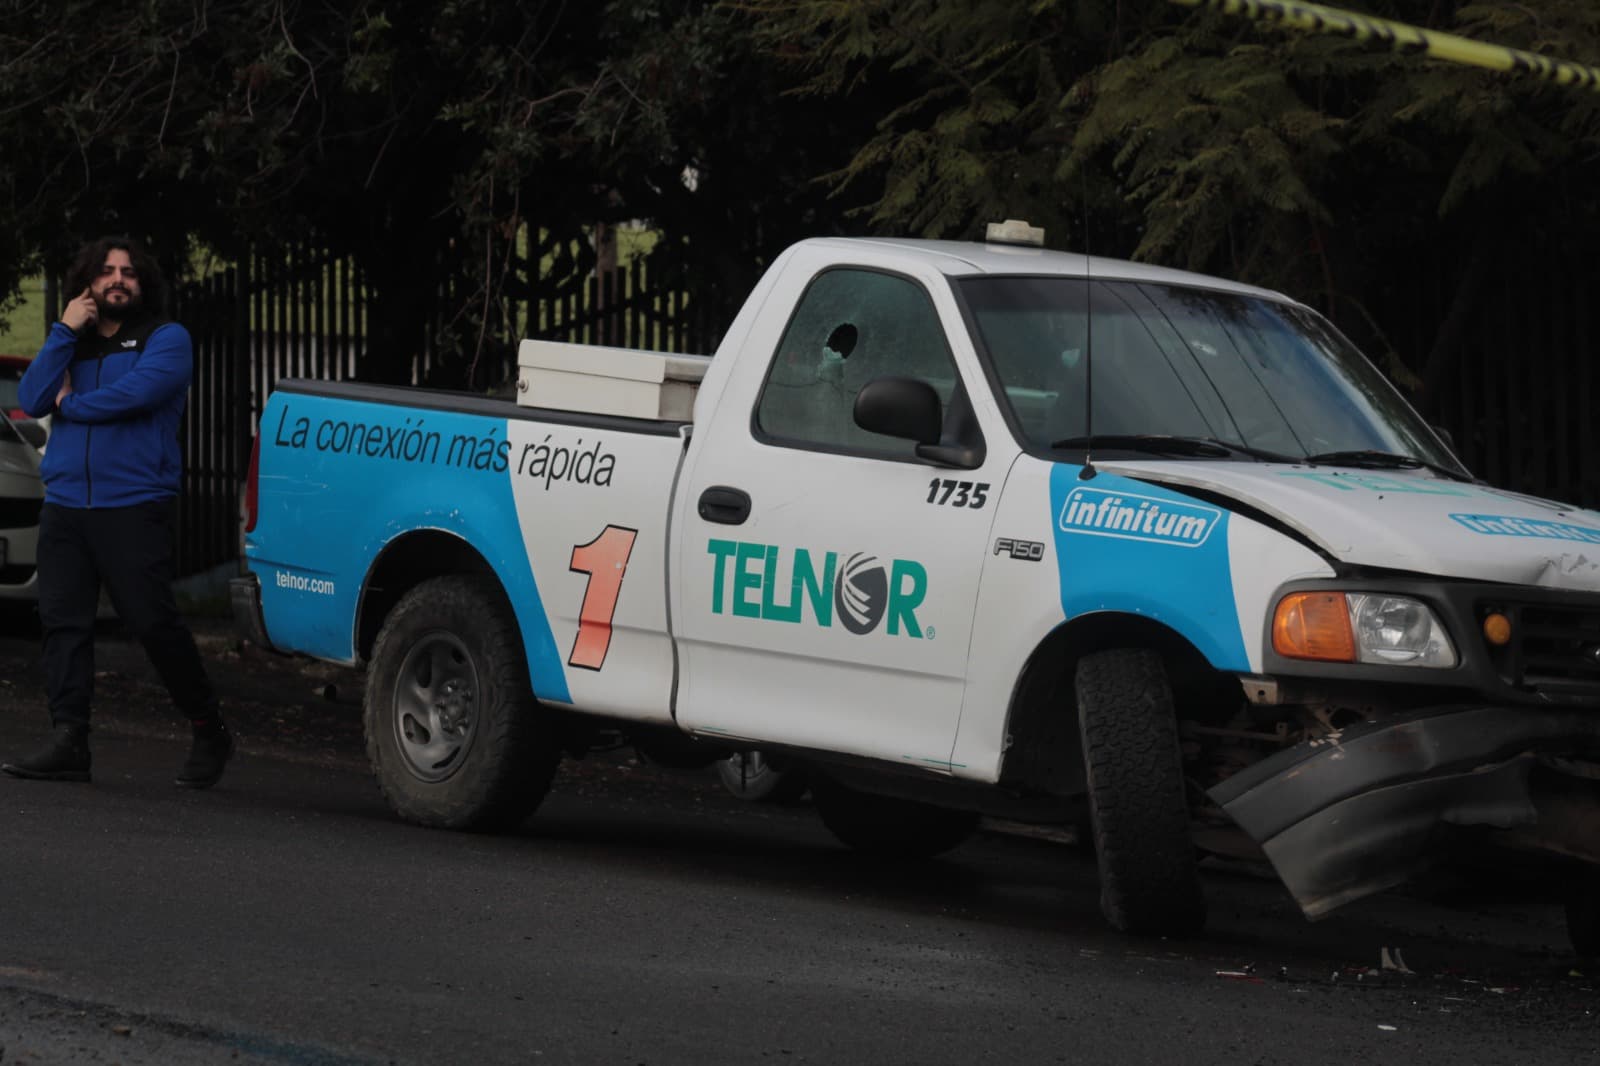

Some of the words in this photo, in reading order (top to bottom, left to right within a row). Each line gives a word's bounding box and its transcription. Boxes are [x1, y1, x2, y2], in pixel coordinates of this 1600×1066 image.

[275, 404, 309, 448] La
[315, 419, 440, 462] conexión
[447, 428, 512, 473] más
[518, 435, 616, 491] rápida
[926, 477, 989, 510] 1735
[1067, 493, 1207, 539] infinitum
[275, 570, 335, 595] telnor.com
[567, 524, 639, 672] 1
